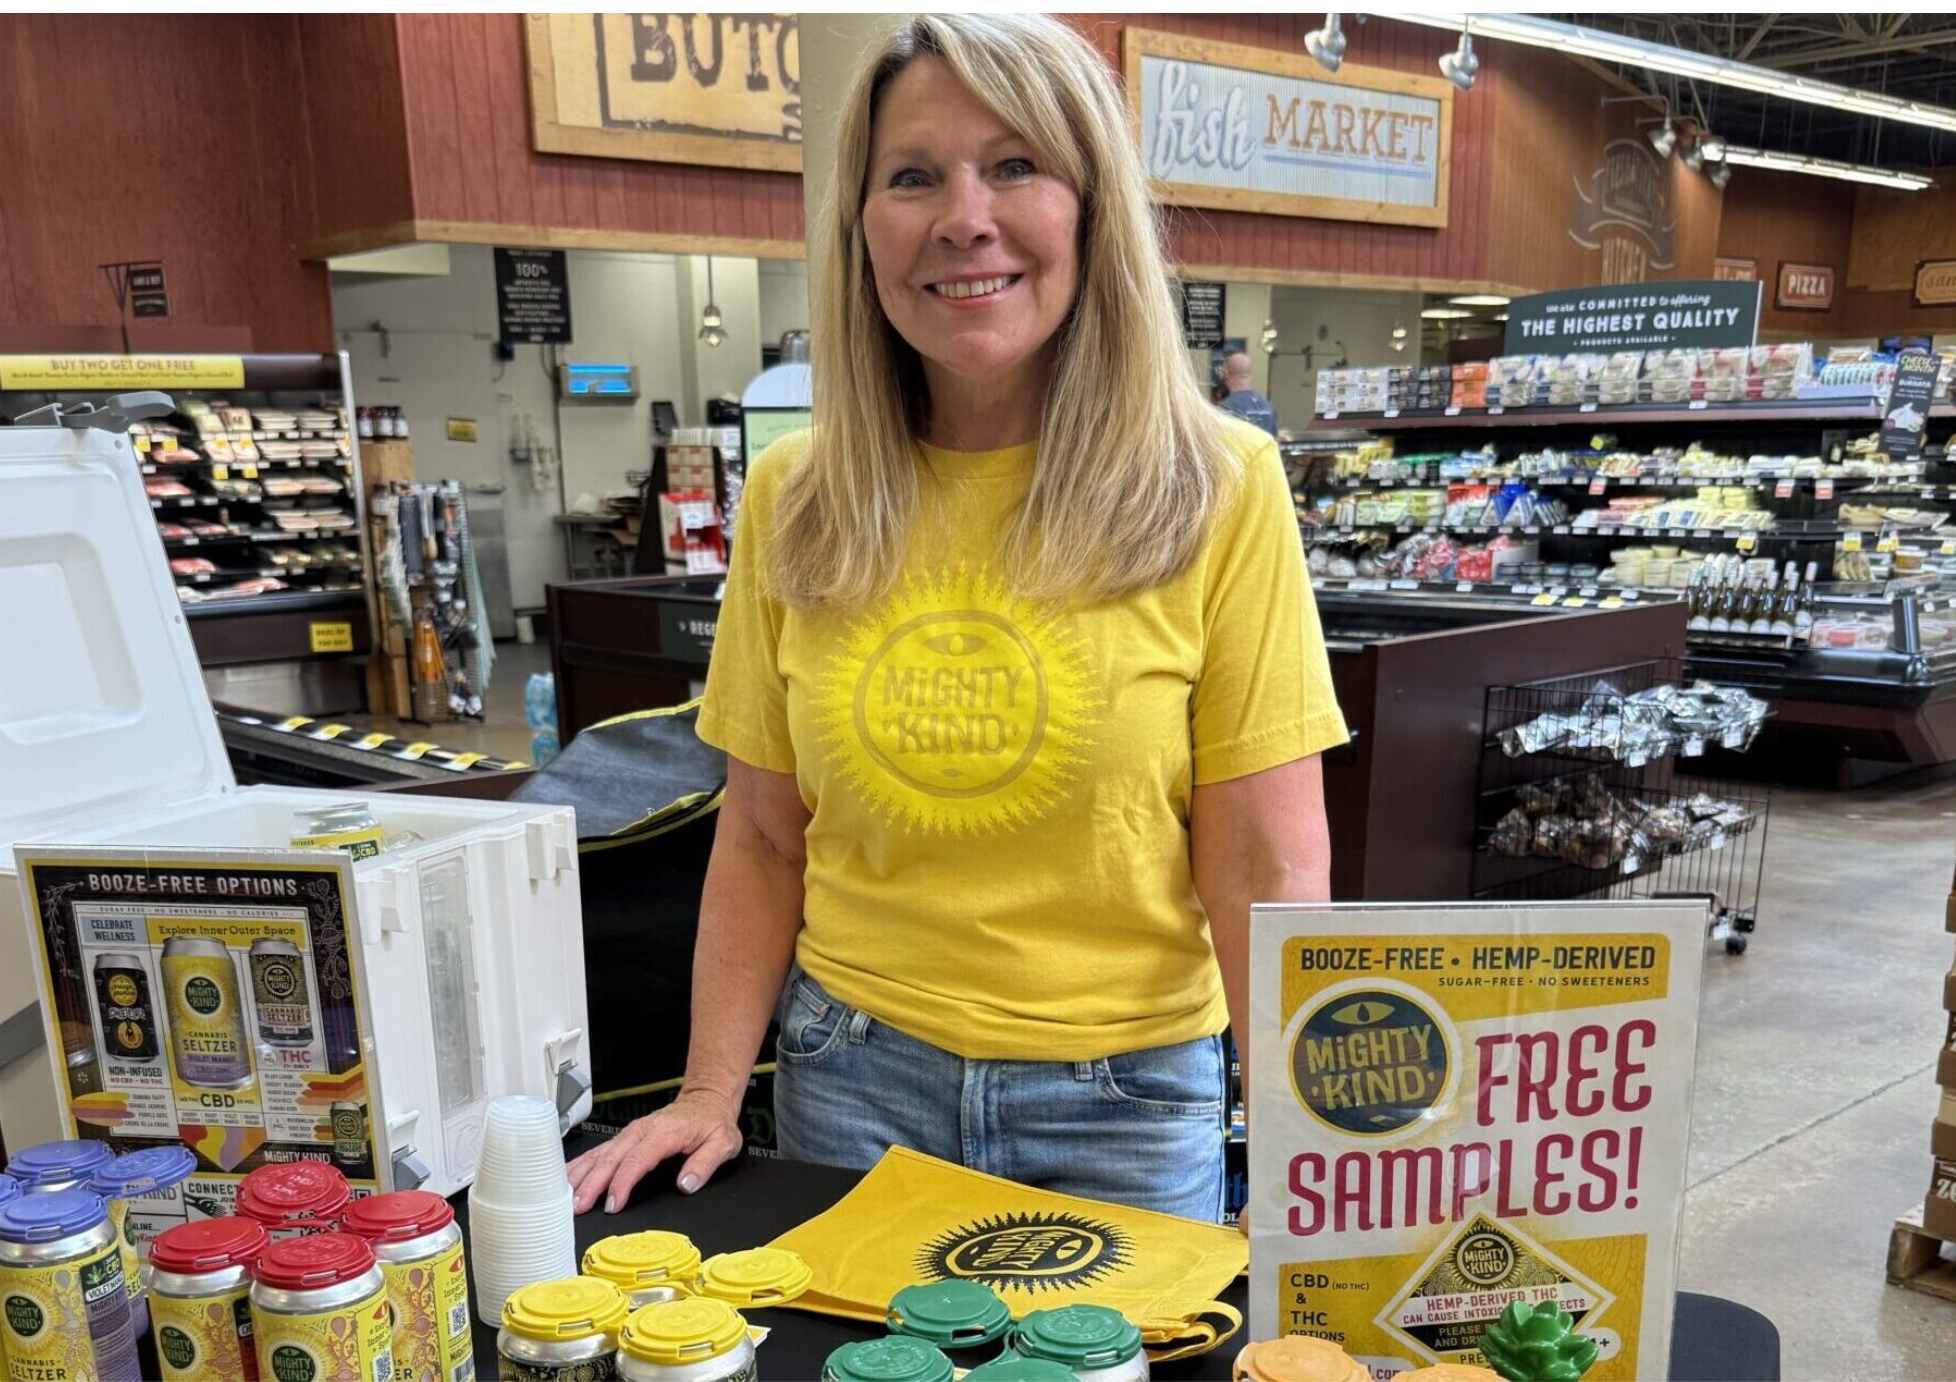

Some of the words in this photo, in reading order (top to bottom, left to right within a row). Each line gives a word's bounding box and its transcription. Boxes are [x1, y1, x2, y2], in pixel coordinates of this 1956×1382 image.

[1152, 60, 1257, 180] fish
[1264, 94, 1433, 163] MARKET
[1788, 275, 1826, 296] PIZZA
[1578, 296, 1657, 311] COMMITTED
[1670, 294, 1711, 307] offering
[1522, 319, 1556, 337] THE
[1563, 314, 1646, 334] HIGHEST
[1653, 308, 1740, 329] QUALITY
[1580, 338, 1623, 347] PRODUCTS
[1626, 335, 1668, 344] AVAILABLE
[51, 360, 78, 371] BUY
[80, 360, 109, 370] TWO
[110, 360, 135, 370] GET
[137, 360, 164, 370] ONE
[166, 360, 196, 370] FREE
[897, 711, 1007, 756] KIND
[89, 874, 208, 894] BOOZE-FREE
[217, 877, 298, 895] OPTIONS
[91, 919, 133, 930] CELEBRATE
[158, 925, 197, 937] Explore
[200, 925, 228, 935] Inner
[229, 926, 260, 936] Outer
[263, 926, 296, 937] Space
[94, 930, 136, 942] WELLNESS
[1301, 947, 1445, 970] BOOZE-FREE
[1472, 945, 1656, 971] HEMP-DERIVED
[1438, 977, 1525, 988] SUGAR-FREE
[1538, 977, 1557, 987] NO
[1561, 976, 1651, 987] SWEETENERS
[265, 1013, 302, 1021] SELTZER
[182, 1039, 237, 1053] SELTZER
[280, 1050, 312, 1063] THC
[109, 1066, 163, 1078] NON-INFUSED
[1475, 1018, 1657, 1127] FREE
[1325, 1064, 1425, 1111] KIND
[200, 1093, 235, 1108] CBD
[1287, 1126, 1644, 1237] SAMPLES!
[1470, 1260, 1502, 1274] KIND
[1290, 1273, 1330, 1289] CBD
[1331, 1282, 1348, 1291] (NO
[1349, 1282, 1370, 1291] THC)
[1295, 1292, 1307, 1304] &
[1427, 1290, 1527, 1312] HEMP-DERIVED
[1531, 1287, 1559, 1301] THC
[1290, 1310, 1329, 1327] THC
[1403, 1313, 1423, 1325] CAN
[1427, 1311, 1460, 1323] CAUSE
[1438, 1325, 1482, 1337] PLEASE
[1434, 1337, 1458, 1348] AND
[10, 1361, 67, 1381] SELTZER
